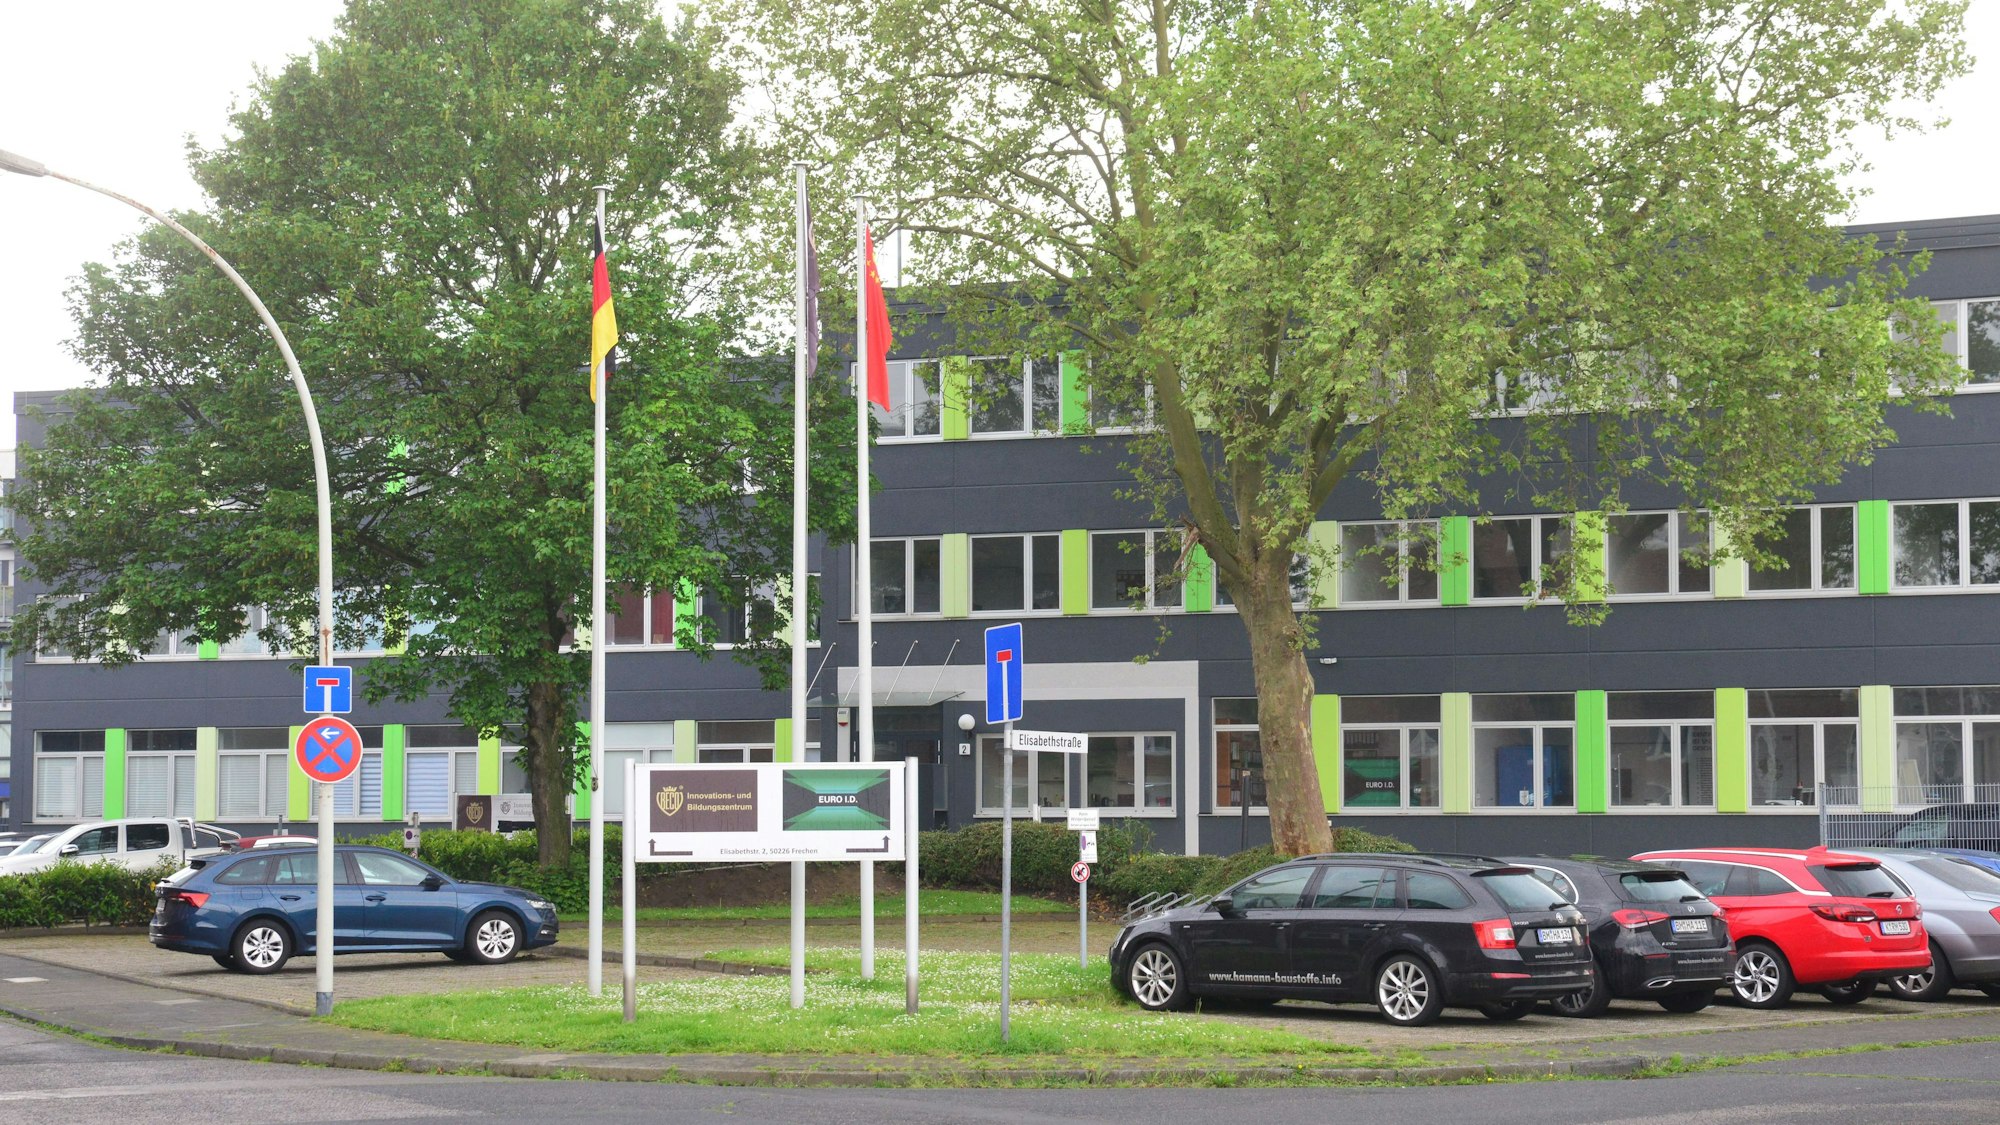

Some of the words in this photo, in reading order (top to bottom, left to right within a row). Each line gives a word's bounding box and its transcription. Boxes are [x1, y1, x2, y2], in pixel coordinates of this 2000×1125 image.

[1019, 733, 1082, 748] Elisabethstraße
[1365, 781, 1383, 789] EURO
[1384, 781, 1395, 789] I.D.
[818, 794, 843, 804] EURO
[843, 794, 859, 804] I.D.
[687, 803, 753, 812] Bildungszentrum
[720, 847, 761, 855] Elisabethstr.
[769, 847, 791, 855] 50226
[791, 847, 819, 855] Frechen
[1208, 971, 1342, 985] www.hamann-baustoffe.info
